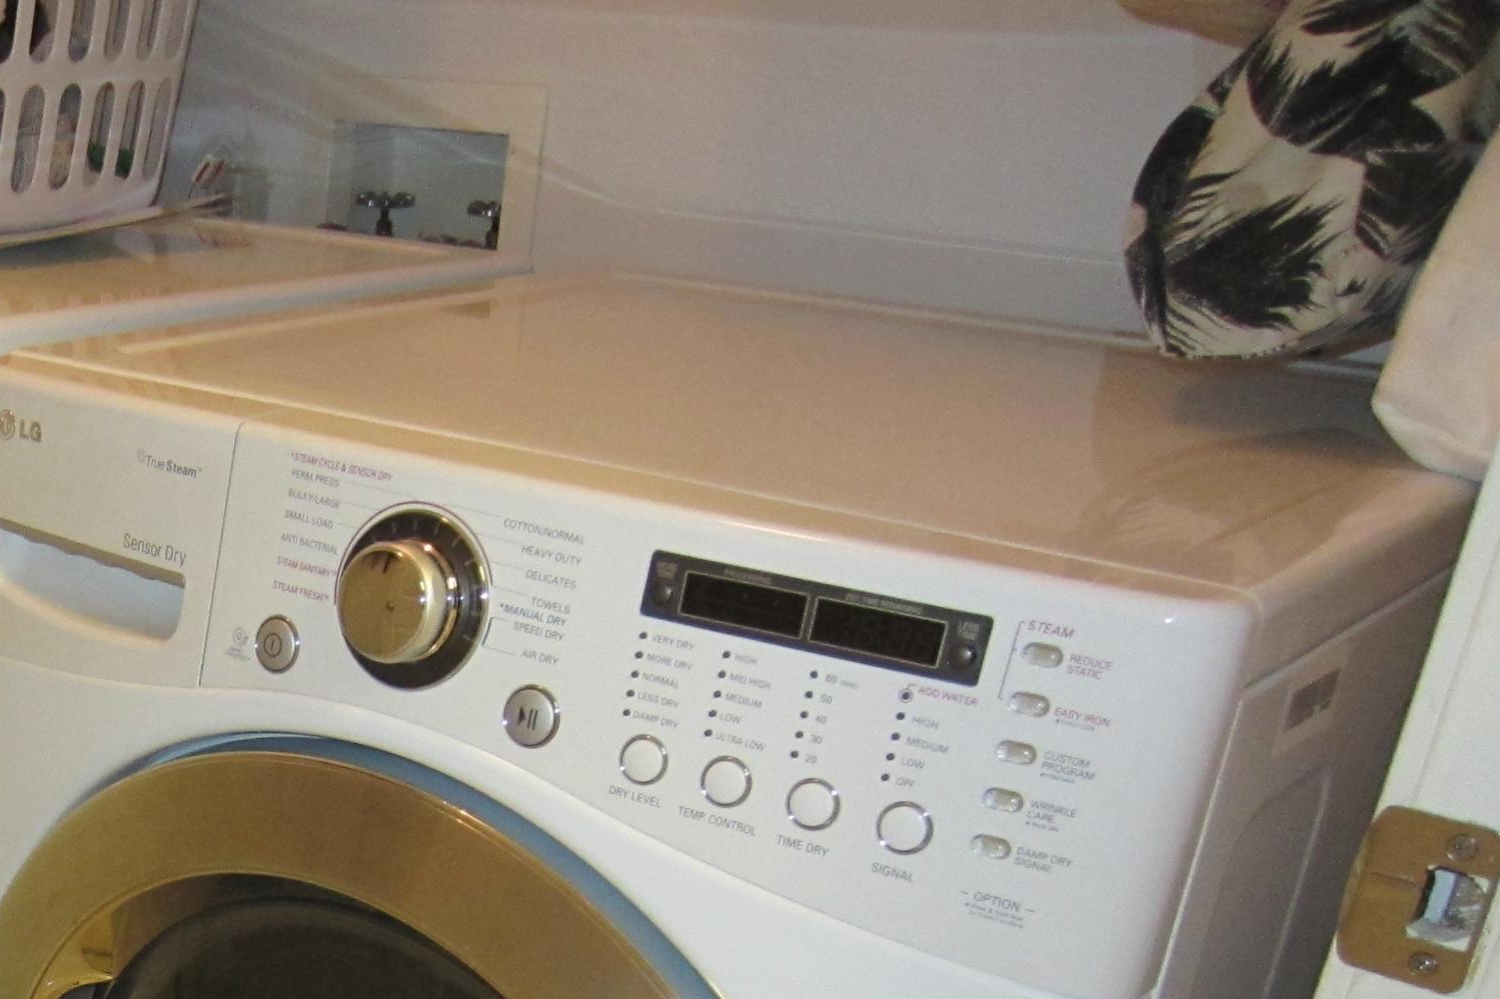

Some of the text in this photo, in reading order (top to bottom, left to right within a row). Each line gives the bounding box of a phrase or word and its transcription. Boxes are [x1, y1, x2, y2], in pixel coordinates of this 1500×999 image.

[19, 419, 43, 442] LG
[284, 509, 334, 529] SMALL LOAD
[123, 533, 187, 567] Sensor Dry
[281, 532, 339, 556] ANTI BACTERIAL
[276, 556, 298, 569] STEAM
[521, 545, 582, 566] HEAVY DUTY
[273, 580, 298, 595] STEAM
[525, 569, 577, 591] DELICATES
[531, 596, 571, 615] TOWELS
[546, 614, 567, 627] DRY
[512, 621, 565, 641] SPEED DRY
[1028, 620, 1075, 639] STEAM
[651, 634, 695, 650] VERY DRY
[522, 650, 559, 665] AIR DRY
[647, 653, 693, 671] MORE DRY
[734, 654, 758, 665] HIGH
[1070, 653, 1113, 671] REDUCE
[642, 672, 678, 689] NORMAL
[729, 673, 772, 689] MID HIGH
[1067, 665, 1101, 681] STATIC
[637, 691, 679, 708] LESS DRY
[725, 692, 763, 708] MEDIUM
[917, 686, 978, 707] ADD WATER
[632, 711, 679, 729] DAMP DRY
[719, 712, 742, 724] LOW
[815, 714, 828, 725] 40
[912, 716, 939, 730] HIGH
[1054, 707, 1082, 720] EASY
[1083, 713, 1110, 727] IRON
[715, 732, 765, 751] ULTRA LOW
[810, 734, 823, 745] 30
[907, 737, 949, 754] MEDIUM
[804, 754, 818, 764] 20
[901, 757, 925, 769] LOW
[1044, 751, 1091, 767] CUSTOM
[1042, 761, 1096, 781] PROGRAM
[895, 776, 915, 788] OFF
[608, 784, 661, 809] DRY LEVEL
[1027, 811, 1055, 824] CARE
[1030, 801, 1077, 818] WRINKLE
[708, 814, 756, 837] CONTROL
[777, 834, 830, 858] TIME DRY
[1013, 856, 1052, 873] SIGNAL
[1016, 846, 1073, 867] DAMP DRY
[871, 861, 915, 883] SIGNAL
[973, 891, 1021, 913] OPTION
